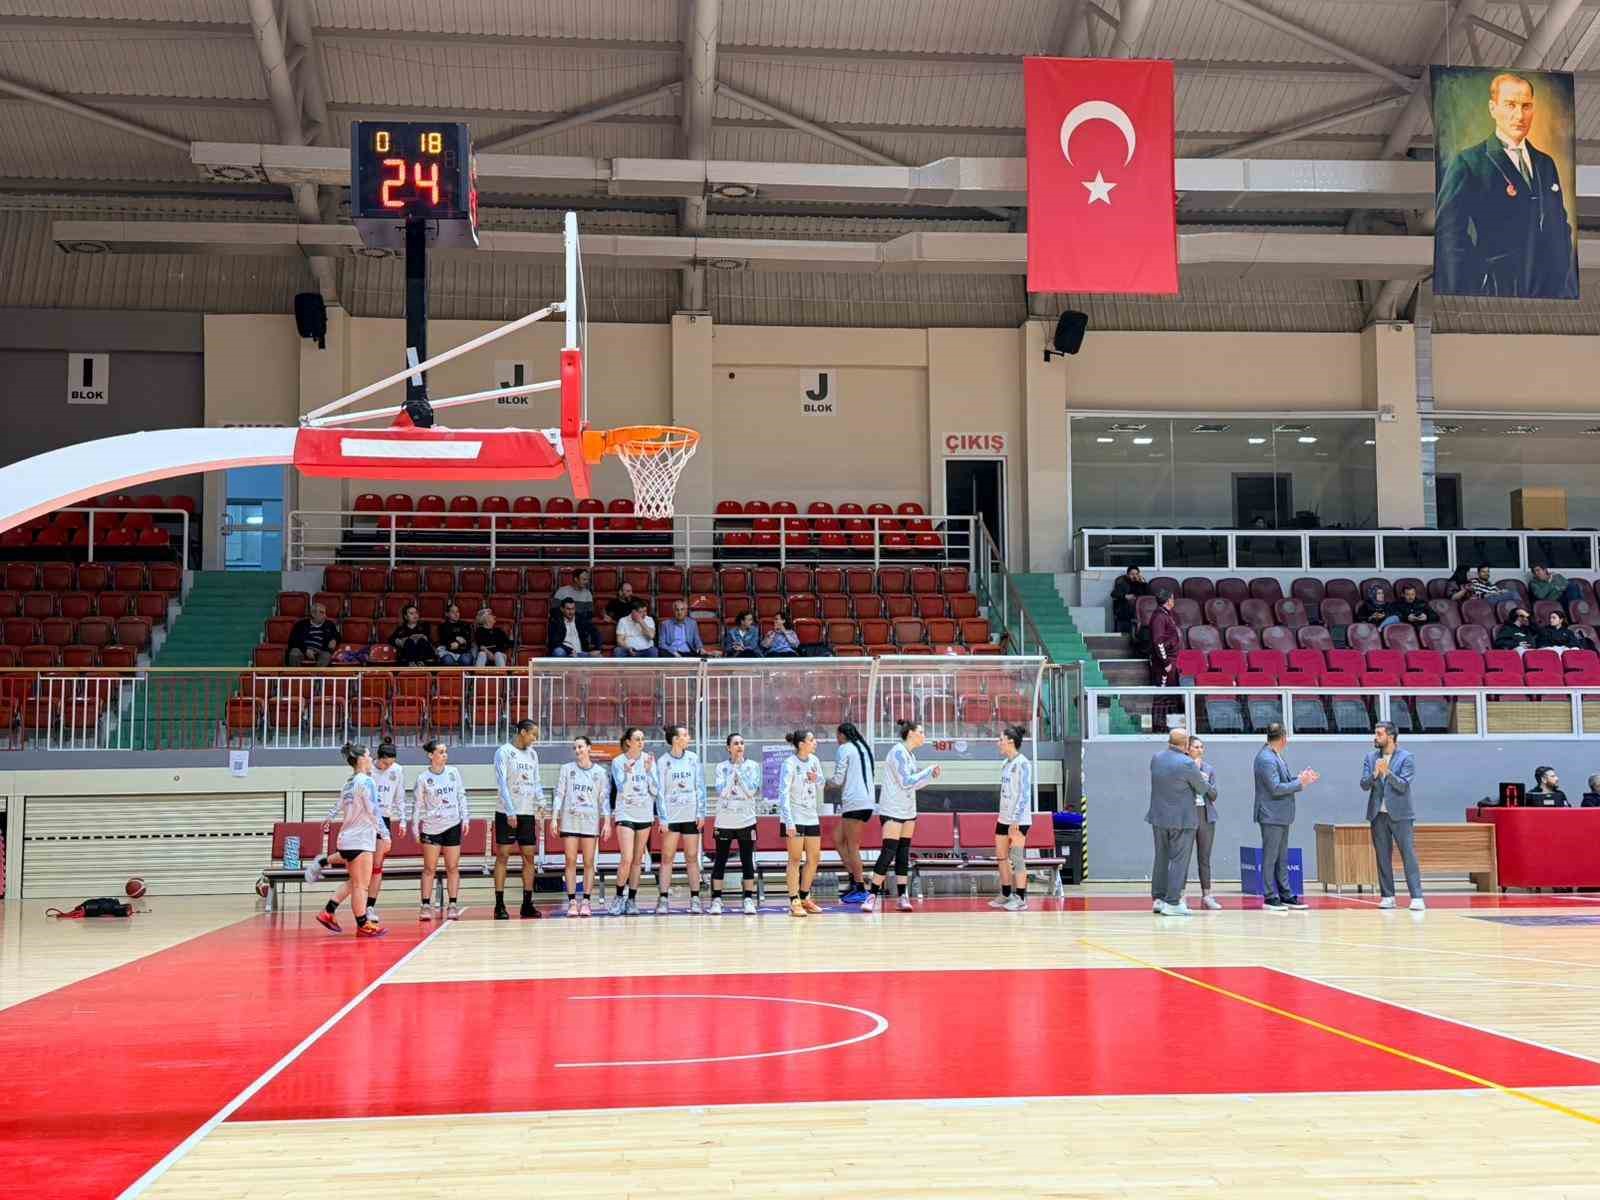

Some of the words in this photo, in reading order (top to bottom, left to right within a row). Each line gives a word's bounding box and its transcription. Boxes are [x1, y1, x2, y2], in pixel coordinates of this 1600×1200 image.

[376, 131, 390, 153] 0
[420, 132, 442, 154] 18
[382, 158, 440, 208] 24
[83, 358, 94, 387] I
[500, 364, 524, 392] J
[71, 391, 104, 400] BLOK
[806, 373, 828, 401] J
[497, 396, 529, 405] BLOK
[803, 403, 832, 412] BLOK
[946, 435, 1004, 453] ÇIKIŞ
